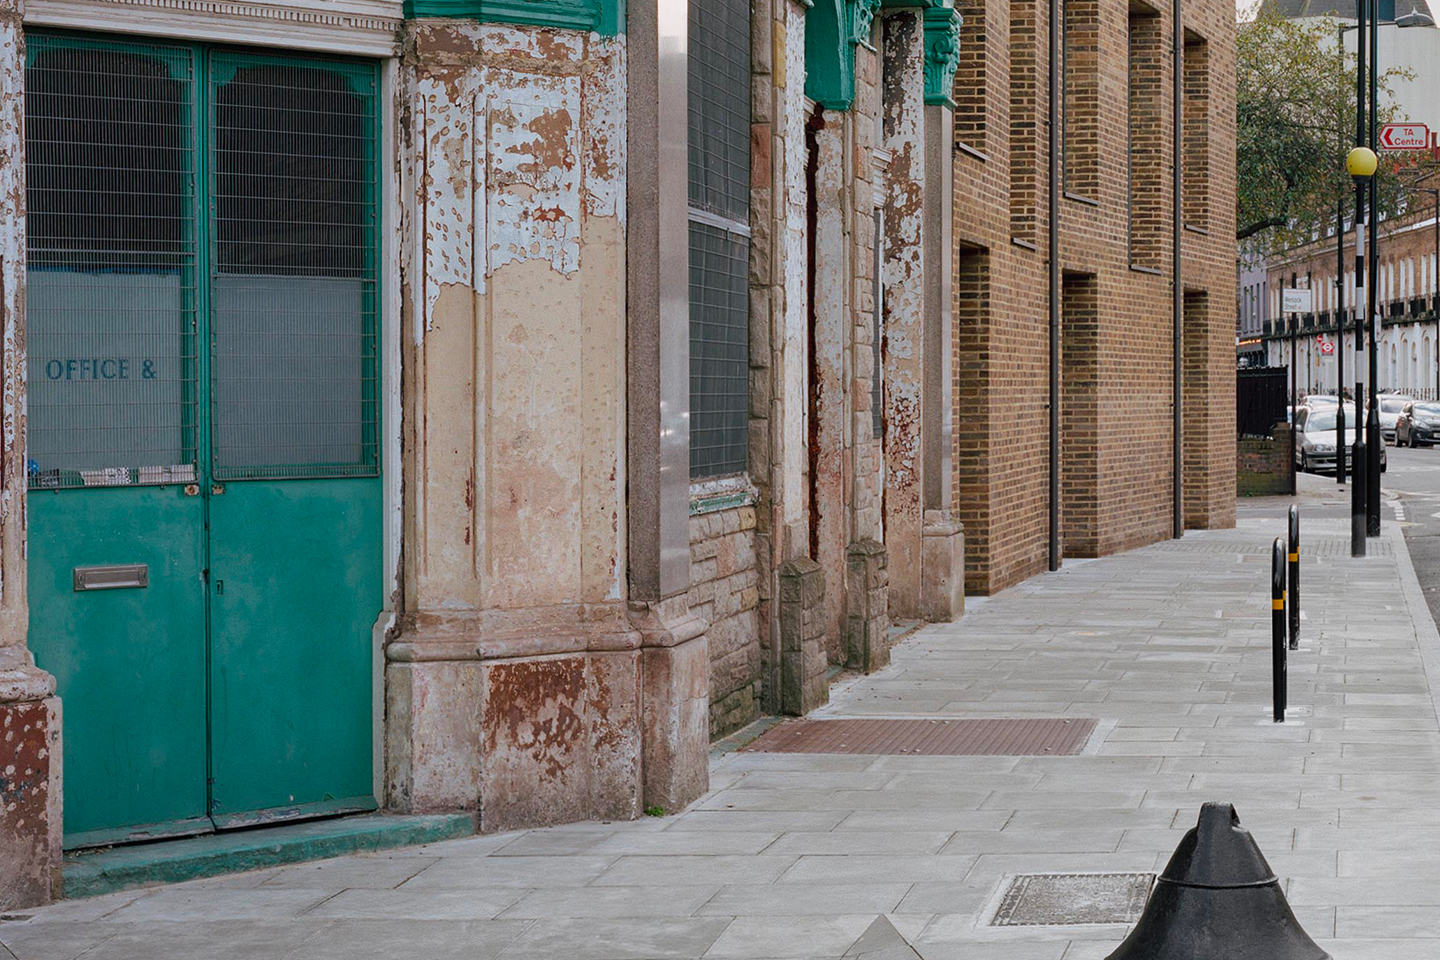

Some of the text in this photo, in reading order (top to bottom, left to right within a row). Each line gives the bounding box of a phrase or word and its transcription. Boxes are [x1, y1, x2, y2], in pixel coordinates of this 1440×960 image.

[1403, 128, 1414, 136] TA
[1394, 137, 1424, 145] Centre
[45, 359, 158, 380] OFFICE &
